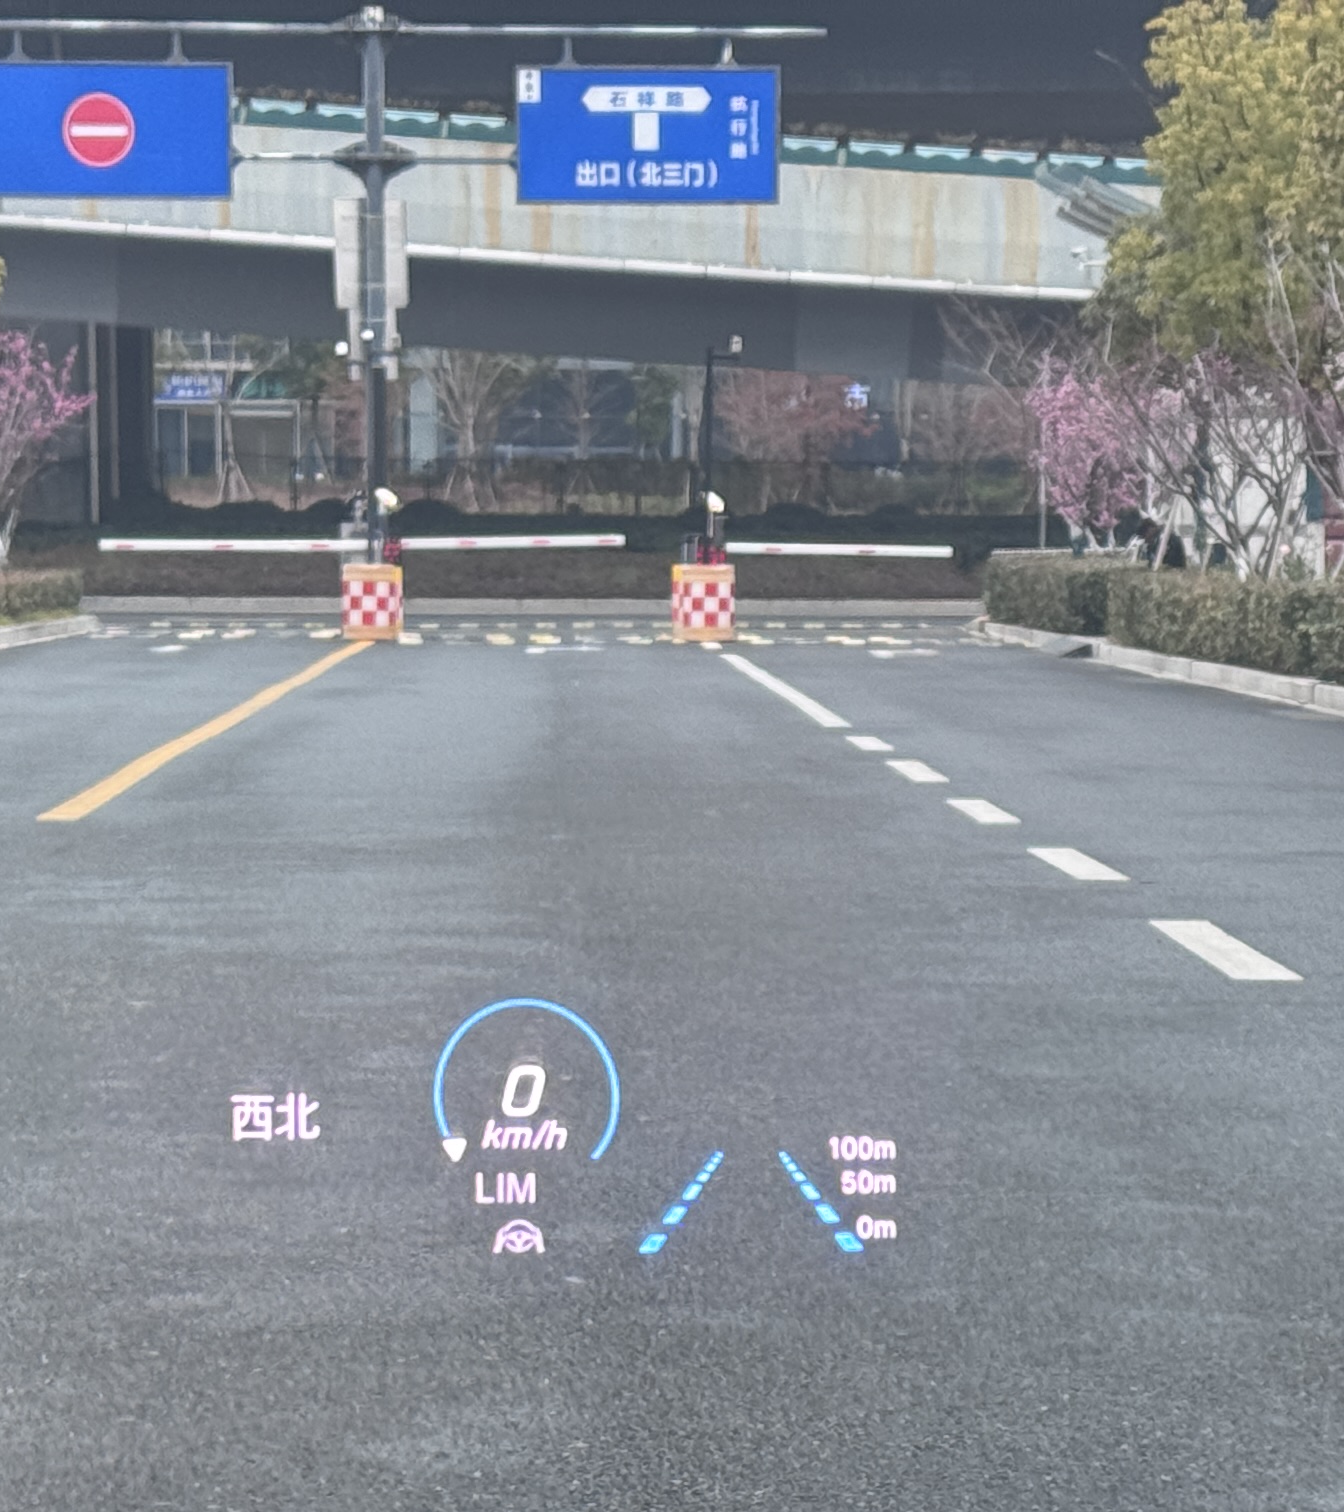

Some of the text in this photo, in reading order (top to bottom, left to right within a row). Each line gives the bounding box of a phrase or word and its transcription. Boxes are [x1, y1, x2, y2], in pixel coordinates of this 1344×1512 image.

[575, 159, 719, 188] 出口（北三门）
[501, 1064, 546, 1117] 0
[230, 1092, 321, 1141] 西北
[481, 1119, 567, 1150] km/h
[829, 1136, 897, 1161] 100m
[475, 1172, 536, 1204] LIM
[841, 1169, 897, 1195] 50m
[857, 1215, 897, 1239] 0m
